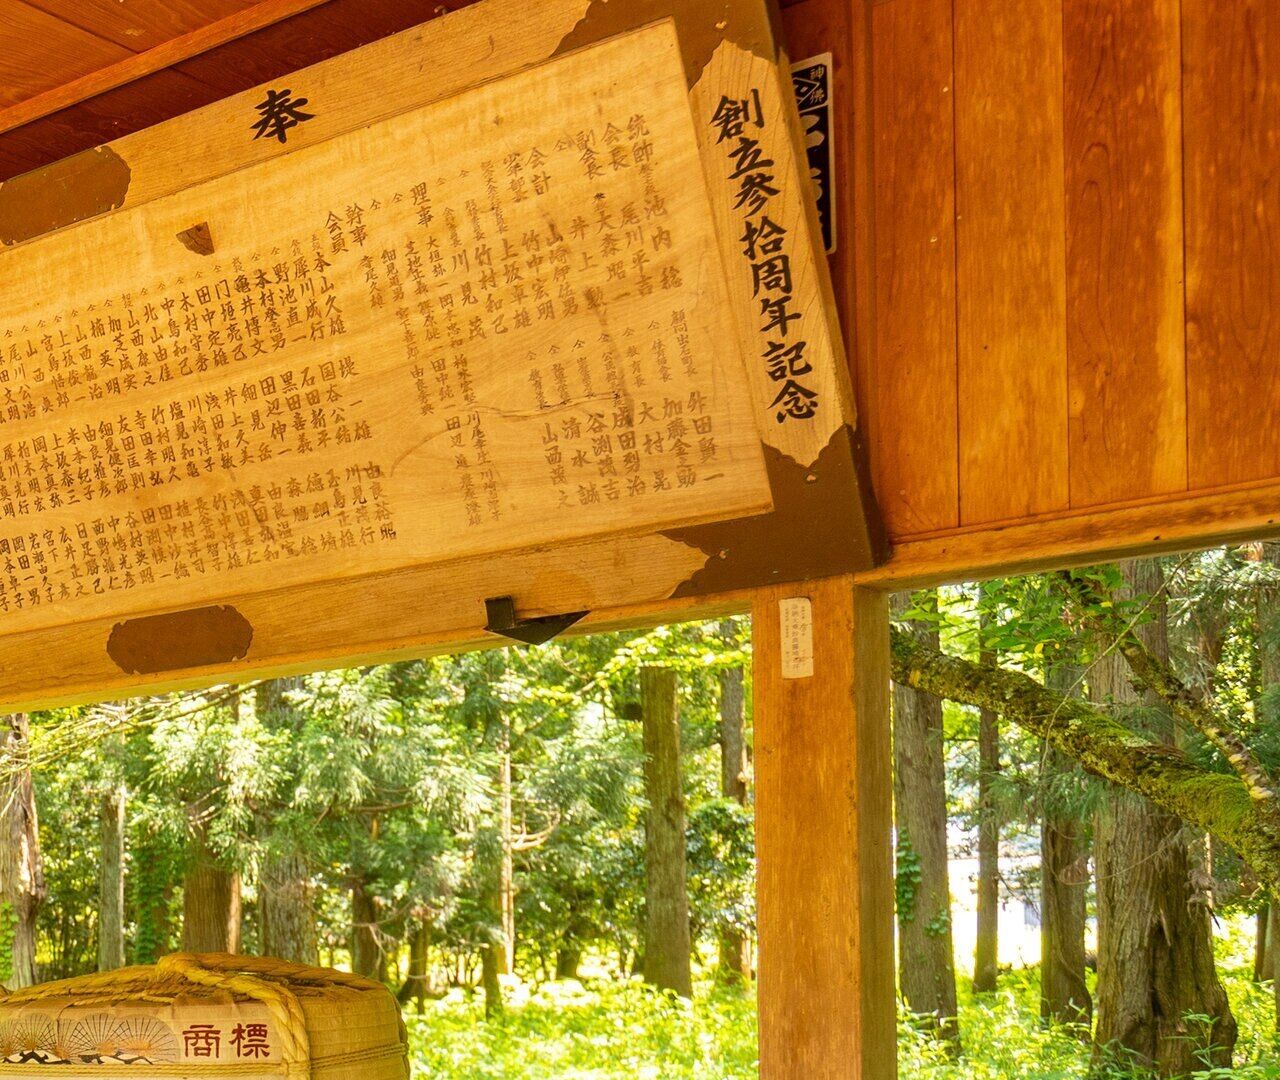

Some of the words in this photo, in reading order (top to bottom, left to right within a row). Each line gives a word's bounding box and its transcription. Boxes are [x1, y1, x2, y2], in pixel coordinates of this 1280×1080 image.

[251, 89, 317, 144] 奉
[600, 122, 631, 172] 会長
[524, 146, 552, 196] 会計
[345, 202, 369, 247] 幹事
[409, 181, 435, 228] 理事
[324, 210, 350, 256] 会員
[182, 1022, 271, 1060] 商標
